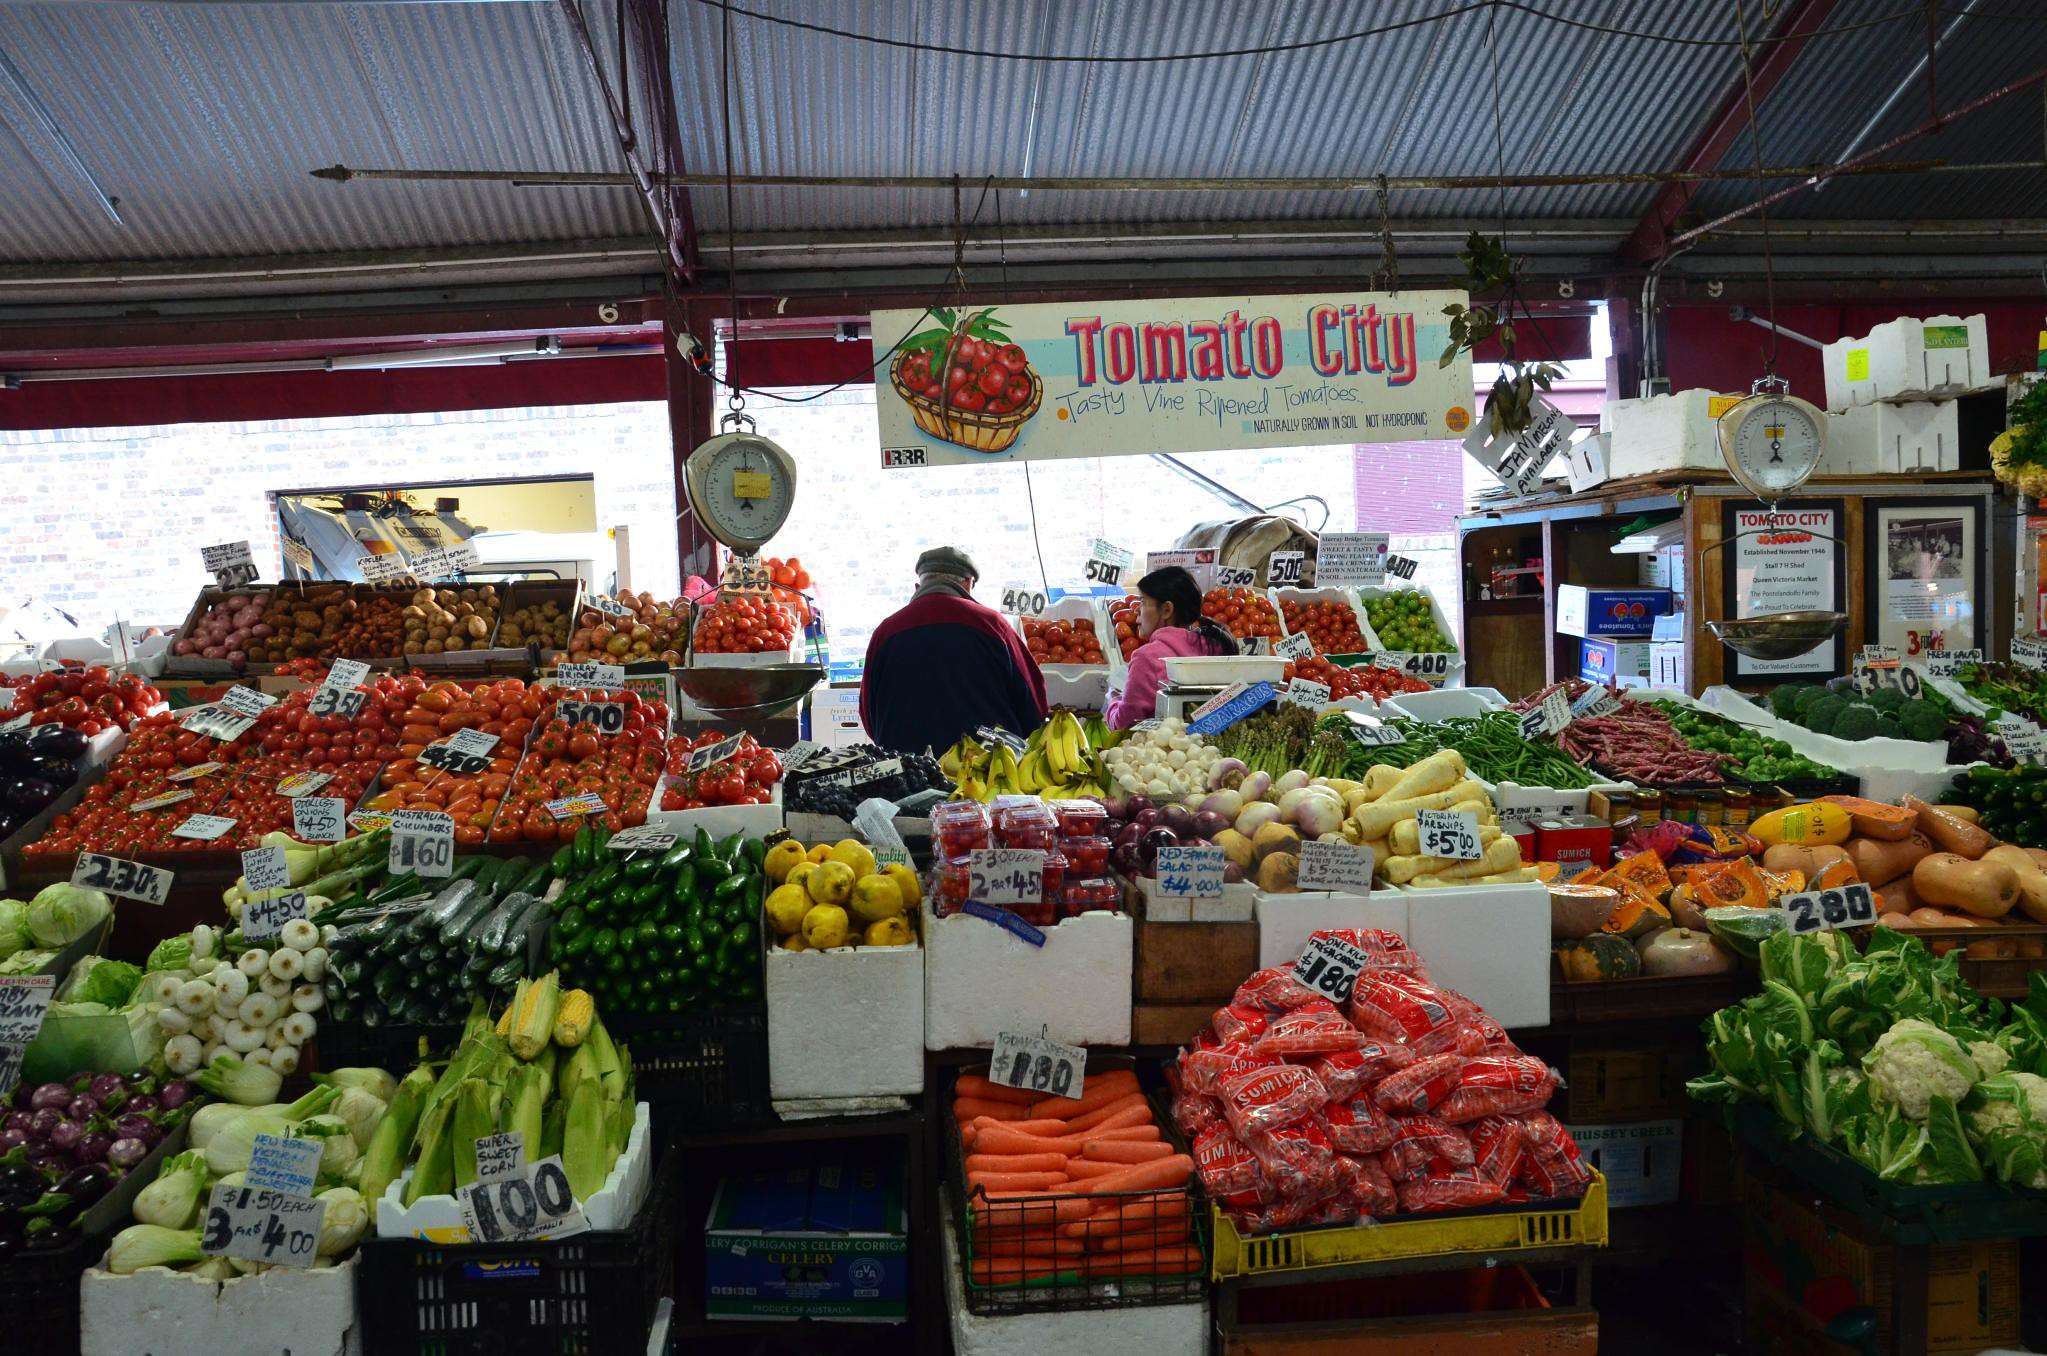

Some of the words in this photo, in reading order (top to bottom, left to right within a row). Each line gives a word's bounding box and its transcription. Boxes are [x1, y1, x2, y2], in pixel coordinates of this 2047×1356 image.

[599, 303, 619, 324] 6
[1064, 310, 1283, 387] Tomato
[1307, 303, 1418, 387] City
[1056, 387, 1126, 423] Tasty
[1143, 385, 1184, 412] Vine
[1199, 388, 1269, 428] Ripened
[1254, 419, 1300, 434] NATURALLY
[1301, 418, 1331, 432] GROWN
[1332, 417, 1341, 430] IN
[1341, 415, 1358, 429] SOIL
[1366, 415, 1379, 428] NOT
[1382, 412, 1428, 427] HYDROPONIC
[1740, 514, 1796, 526] TOMATO
[1800, 513, 1829, 525] CITY
[1802, 590, 1819, 598] Family
[1276, 634, 1305, 651] COOKING
[559, 663, 598, 672] MURRAY
[559, 670, 597, 680] BRIDGE
[390, 809, 452, 822] AUSTRALIAN
[1417, 809, 1460, 820] VICTORIAN
[393, 820, 452, 834] CUCUMBERS
[1417, 818, 1465, 831] PARSNIPS
[243, 846, 275, 860] SWEET
[1159, 848, 1182, 860] RED
[1557, 848, 1591, 860] SUMICH
[1158, 861, 1194, 872] SALAD
[971, 872, 990, 898] 2
[1326, 938, 1347, 951] ONE
[1346, 945, 1367, 961] KILO
[1572, 1129, 1627, 1140] HUSSEY
[1630, 1126, 1675, 1138] CREEK
[476, 1134, 513, 1149] SUPER
[478, 1144, 522, 1162] SWEET
[480, 1162, 517, 1176] CORN
[281, 1201, 317, 1213] EACH
[201, 1206, 233, 1251] 3
[733, 1238, 808, 1251] CORRIGAN'S
[811, 1241, 852, 1250] CELERY
[767, 1251, 835, 1265] CELERY
[752, 1304, 792, 1314] PRODUCE
[792, 1305, 803, 1313] OF
[806, 1305, 852, 1314] AUSTRALIA
